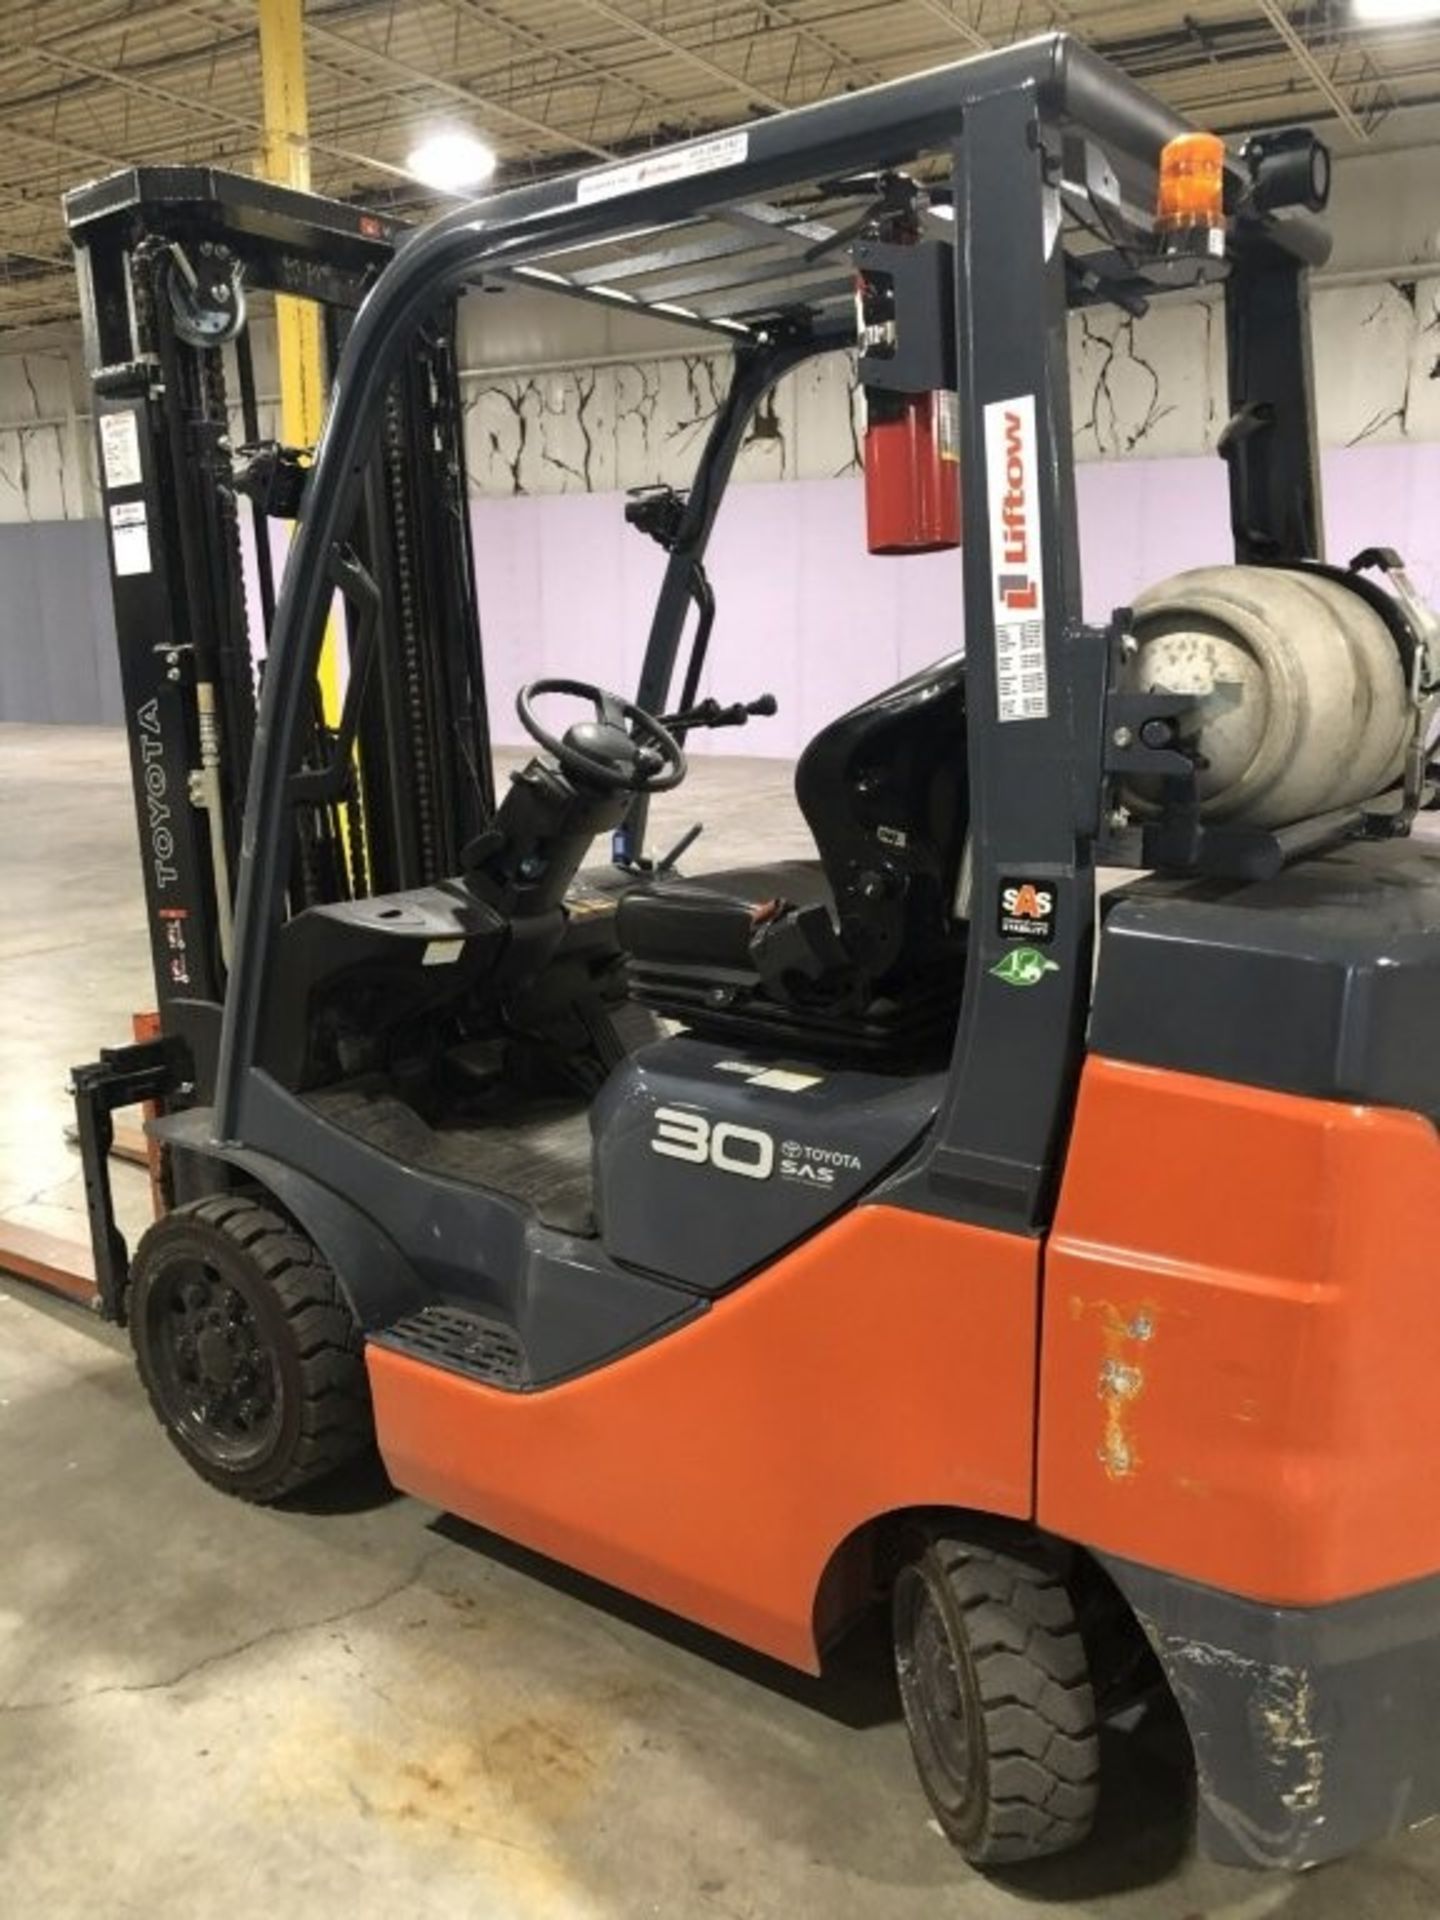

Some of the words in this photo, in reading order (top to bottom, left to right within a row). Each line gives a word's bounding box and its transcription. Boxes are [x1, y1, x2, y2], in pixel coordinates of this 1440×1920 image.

[1002, 411, 1028, 563] Liftow
[136, 697, 179, 889] TOYOTA
[1002, 884, 1053, 919] SAS
[651, 1107, 774, 1180] 30
[804, 1147, 862, 1170] TOYOTA
[779, 1159, 836, 1183] SAS
